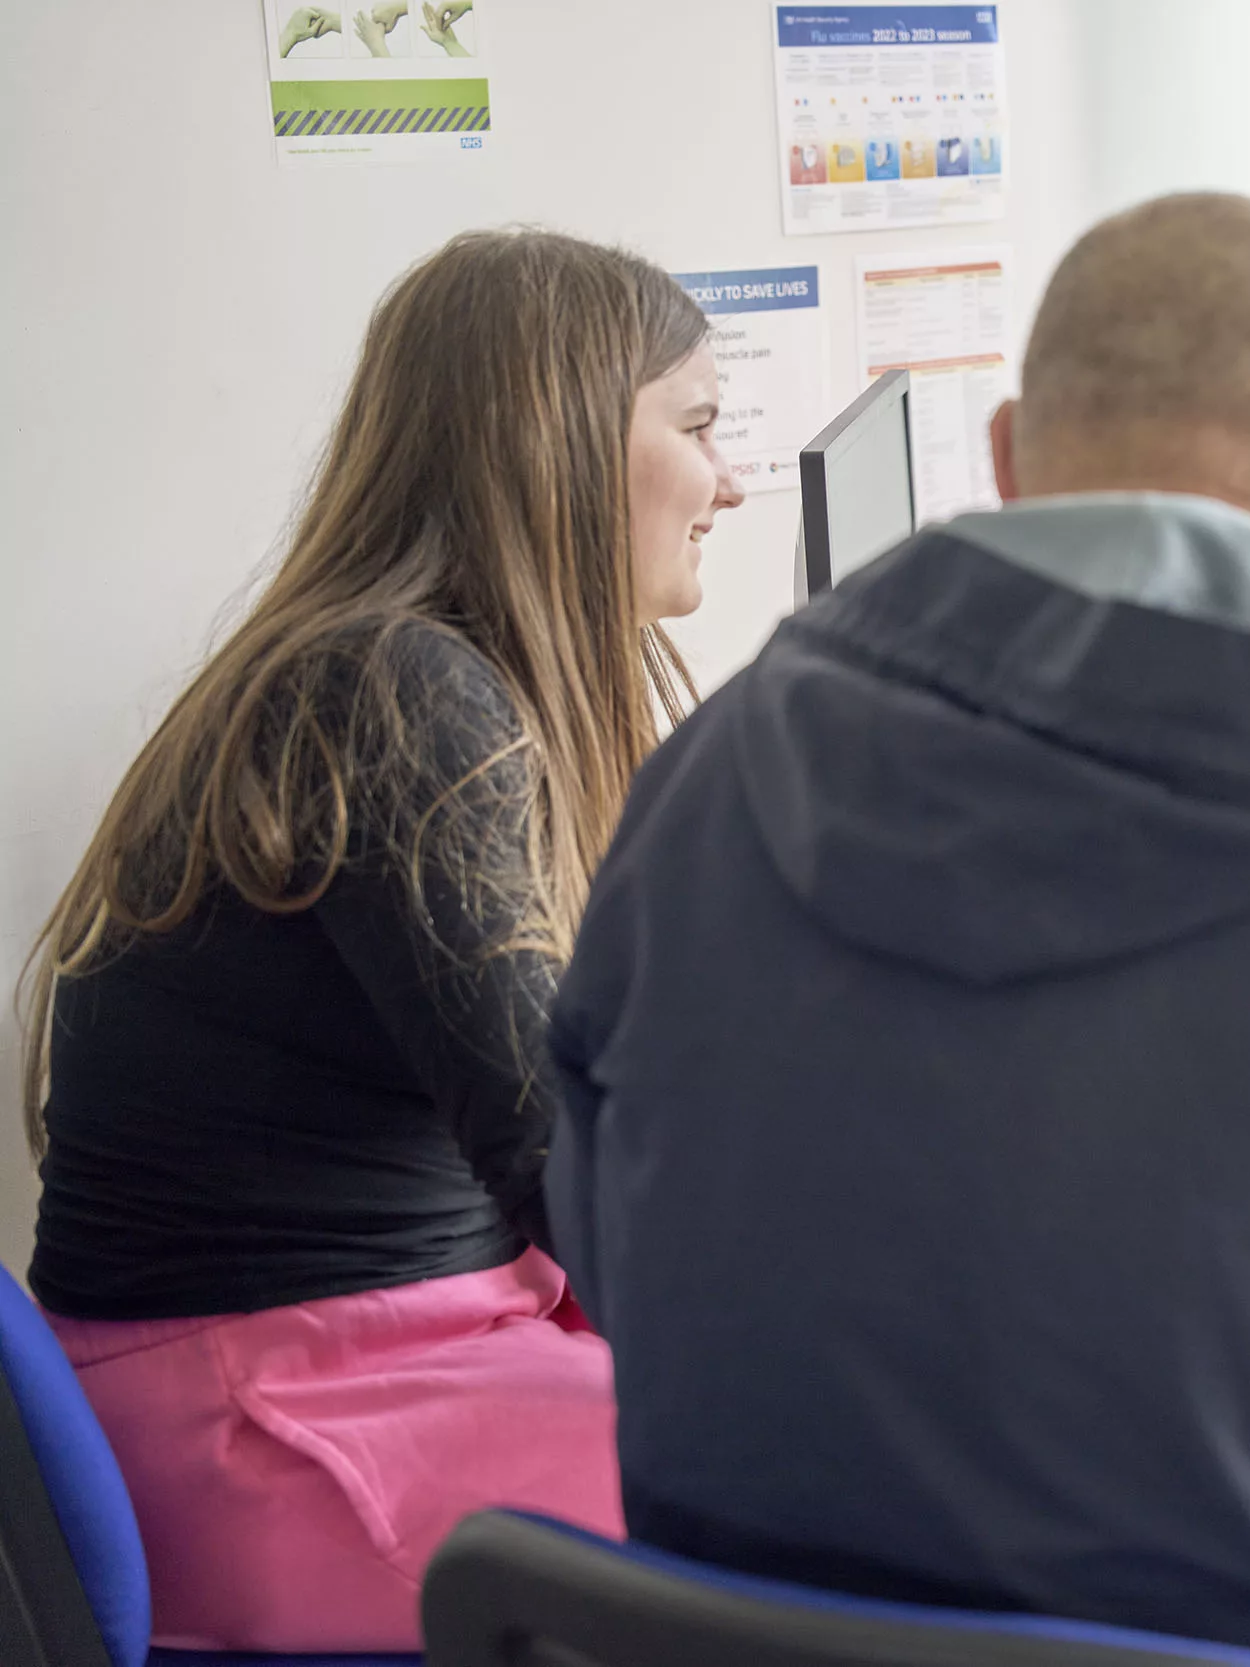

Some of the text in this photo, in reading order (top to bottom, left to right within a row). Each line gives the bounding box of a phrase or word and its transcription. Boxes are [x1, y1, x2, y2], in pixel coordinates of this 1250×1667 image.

[811, 30, 827, 42] Flu
[829, 30, 870, 42] vaccines
[872, 29, 897, 43] 2022
[899, 30, 910, 42] to
[911, 28, 935, 42] 2023
[460, 137, 482, 149] NHS
[725, 286, 742, 300] TO
[743, 283, 774, 299] SAVE
[776, 281, 809, 297] LIVES
